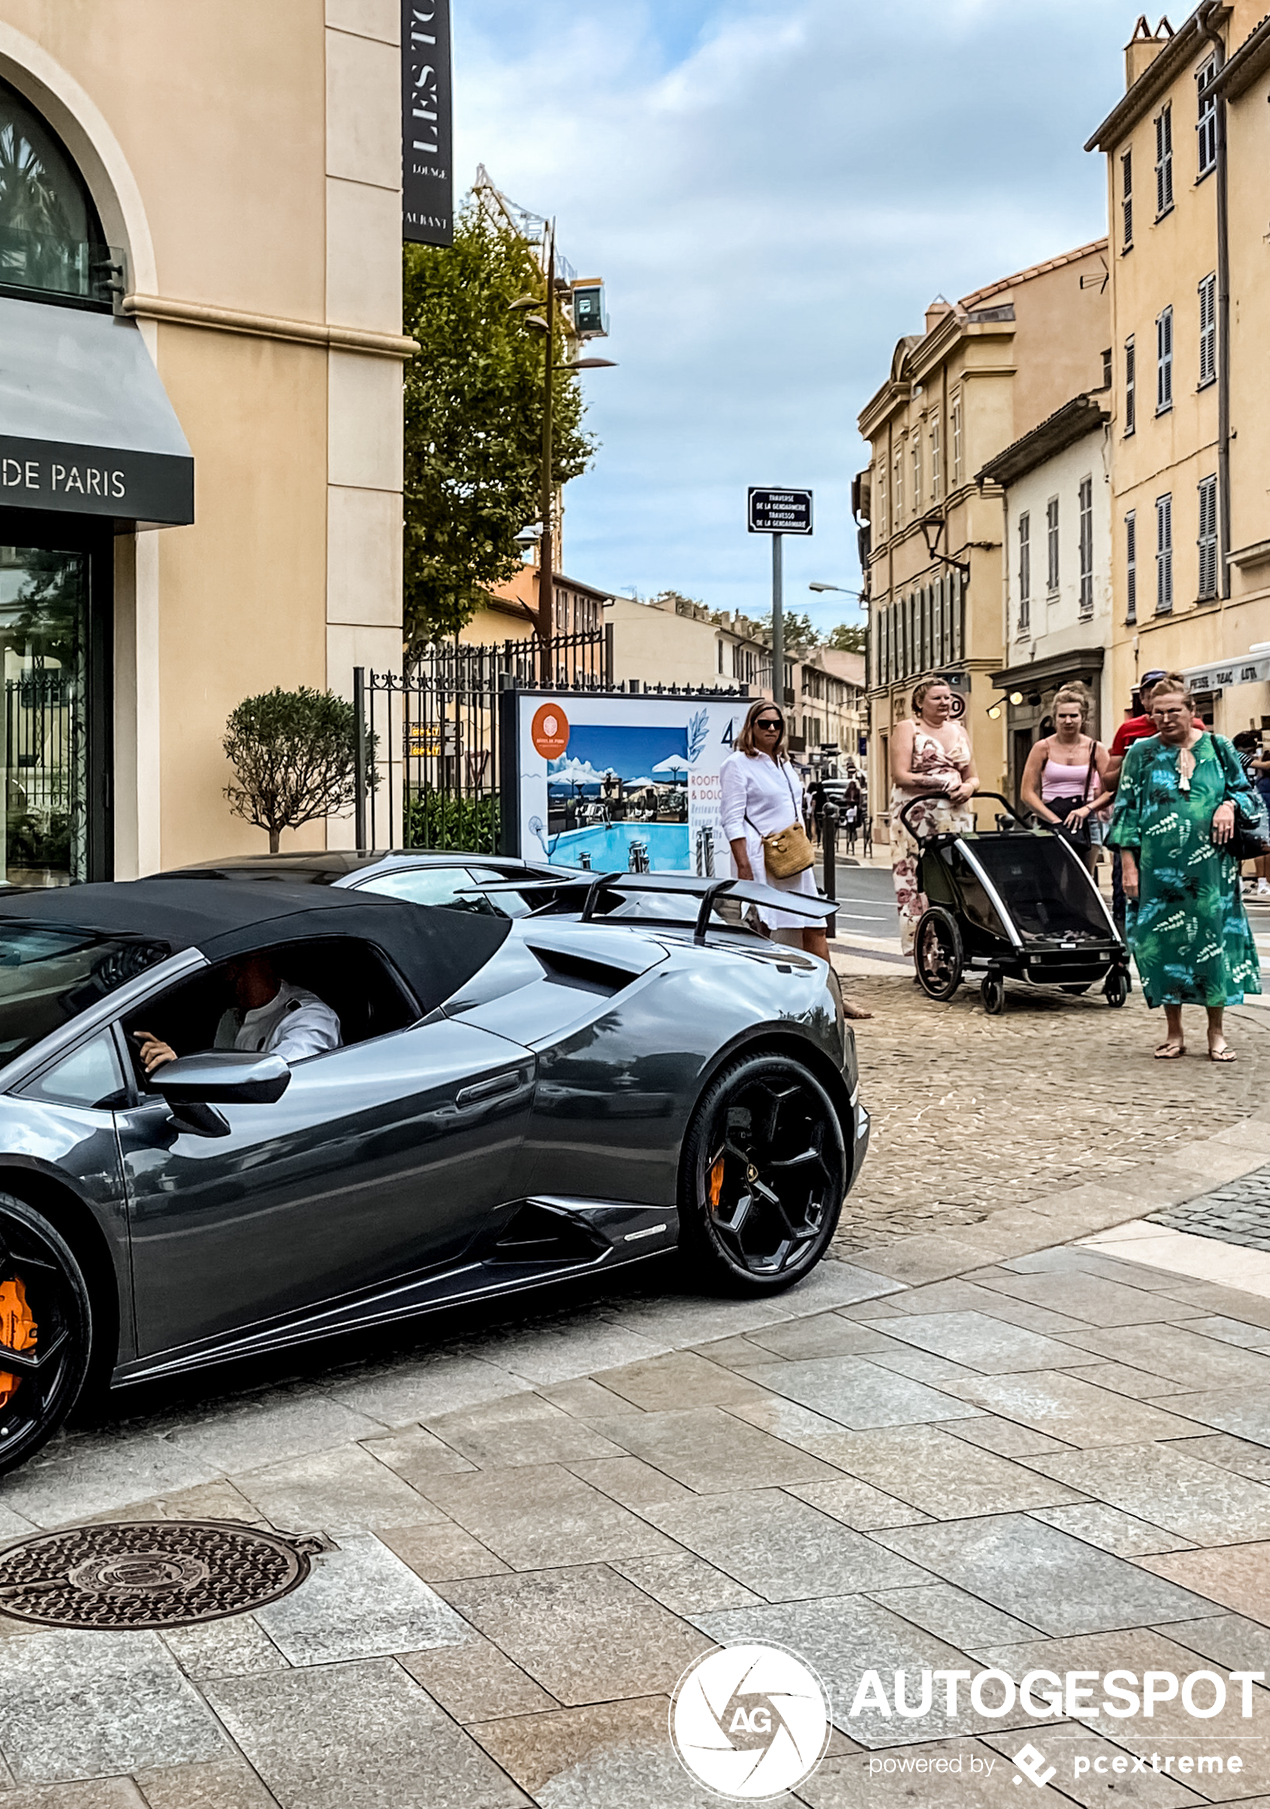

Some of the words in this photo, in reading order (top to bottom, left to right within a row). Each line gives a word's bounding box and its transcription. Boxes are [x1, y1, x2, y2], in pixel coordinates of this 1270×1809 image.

[410, 0, 437, 50] TO
[413, 163, 447, 179] LOUNGE
[404, 211, 447, 229] AURANT
[2, 458, 40, 490] DE
[51, 463, 126, 498] PARIS
[756, 502, 763, 510] DE
[764, 502, 771, 510] LA
[764, 519, 771, 527] LA
[691, 775, 720, 786] ROOFT
